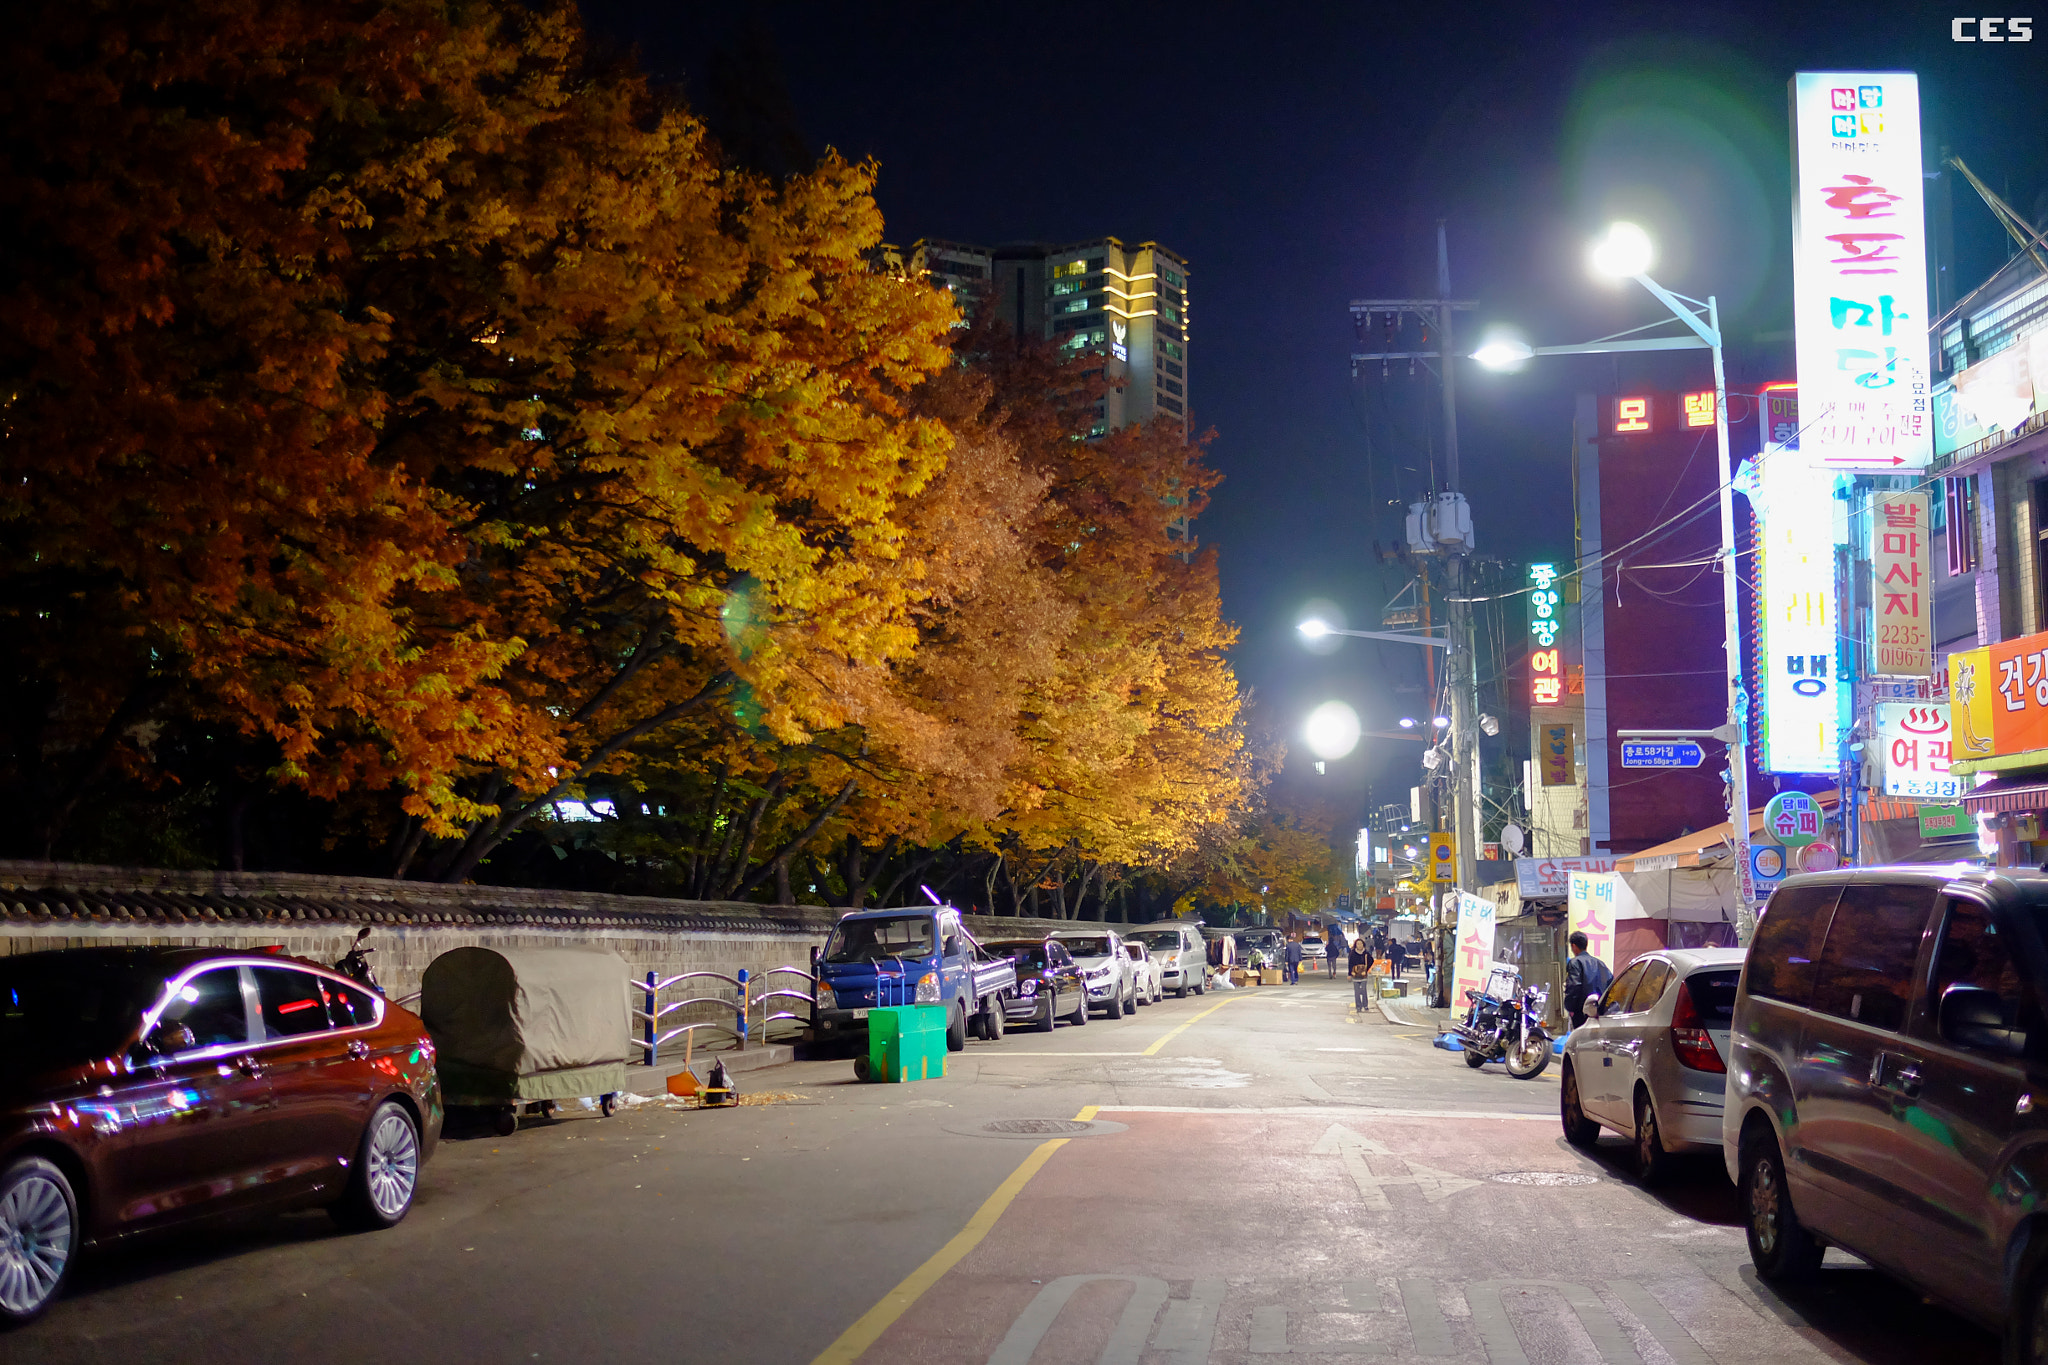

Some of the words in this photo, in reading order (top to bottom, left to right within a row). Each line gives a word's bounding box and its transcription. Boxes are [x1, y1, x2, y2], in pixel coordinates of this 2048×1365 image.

[1616, 392, 1716, 432] 모텔
[1883, 503, 1922, 618] 발마사지
[1532, 649, 1561, 703] 여관
[1625, 746, 1674, 757] 종로58가길
[1654, 758, 1681, 766] 58ga-gil
[1891, 738, 1953, 772] 여관
[1782, 798, 1809, 810] 담배
[1775, 812, 1818, 835] 슈퍼
[1759, 856, 1780, 867] 담배
[1573, 879, 1613, 903] 담배
[1464, 899, 1493, 922] 담배
[1454, 928, 1491, 1009] 슈퍼
